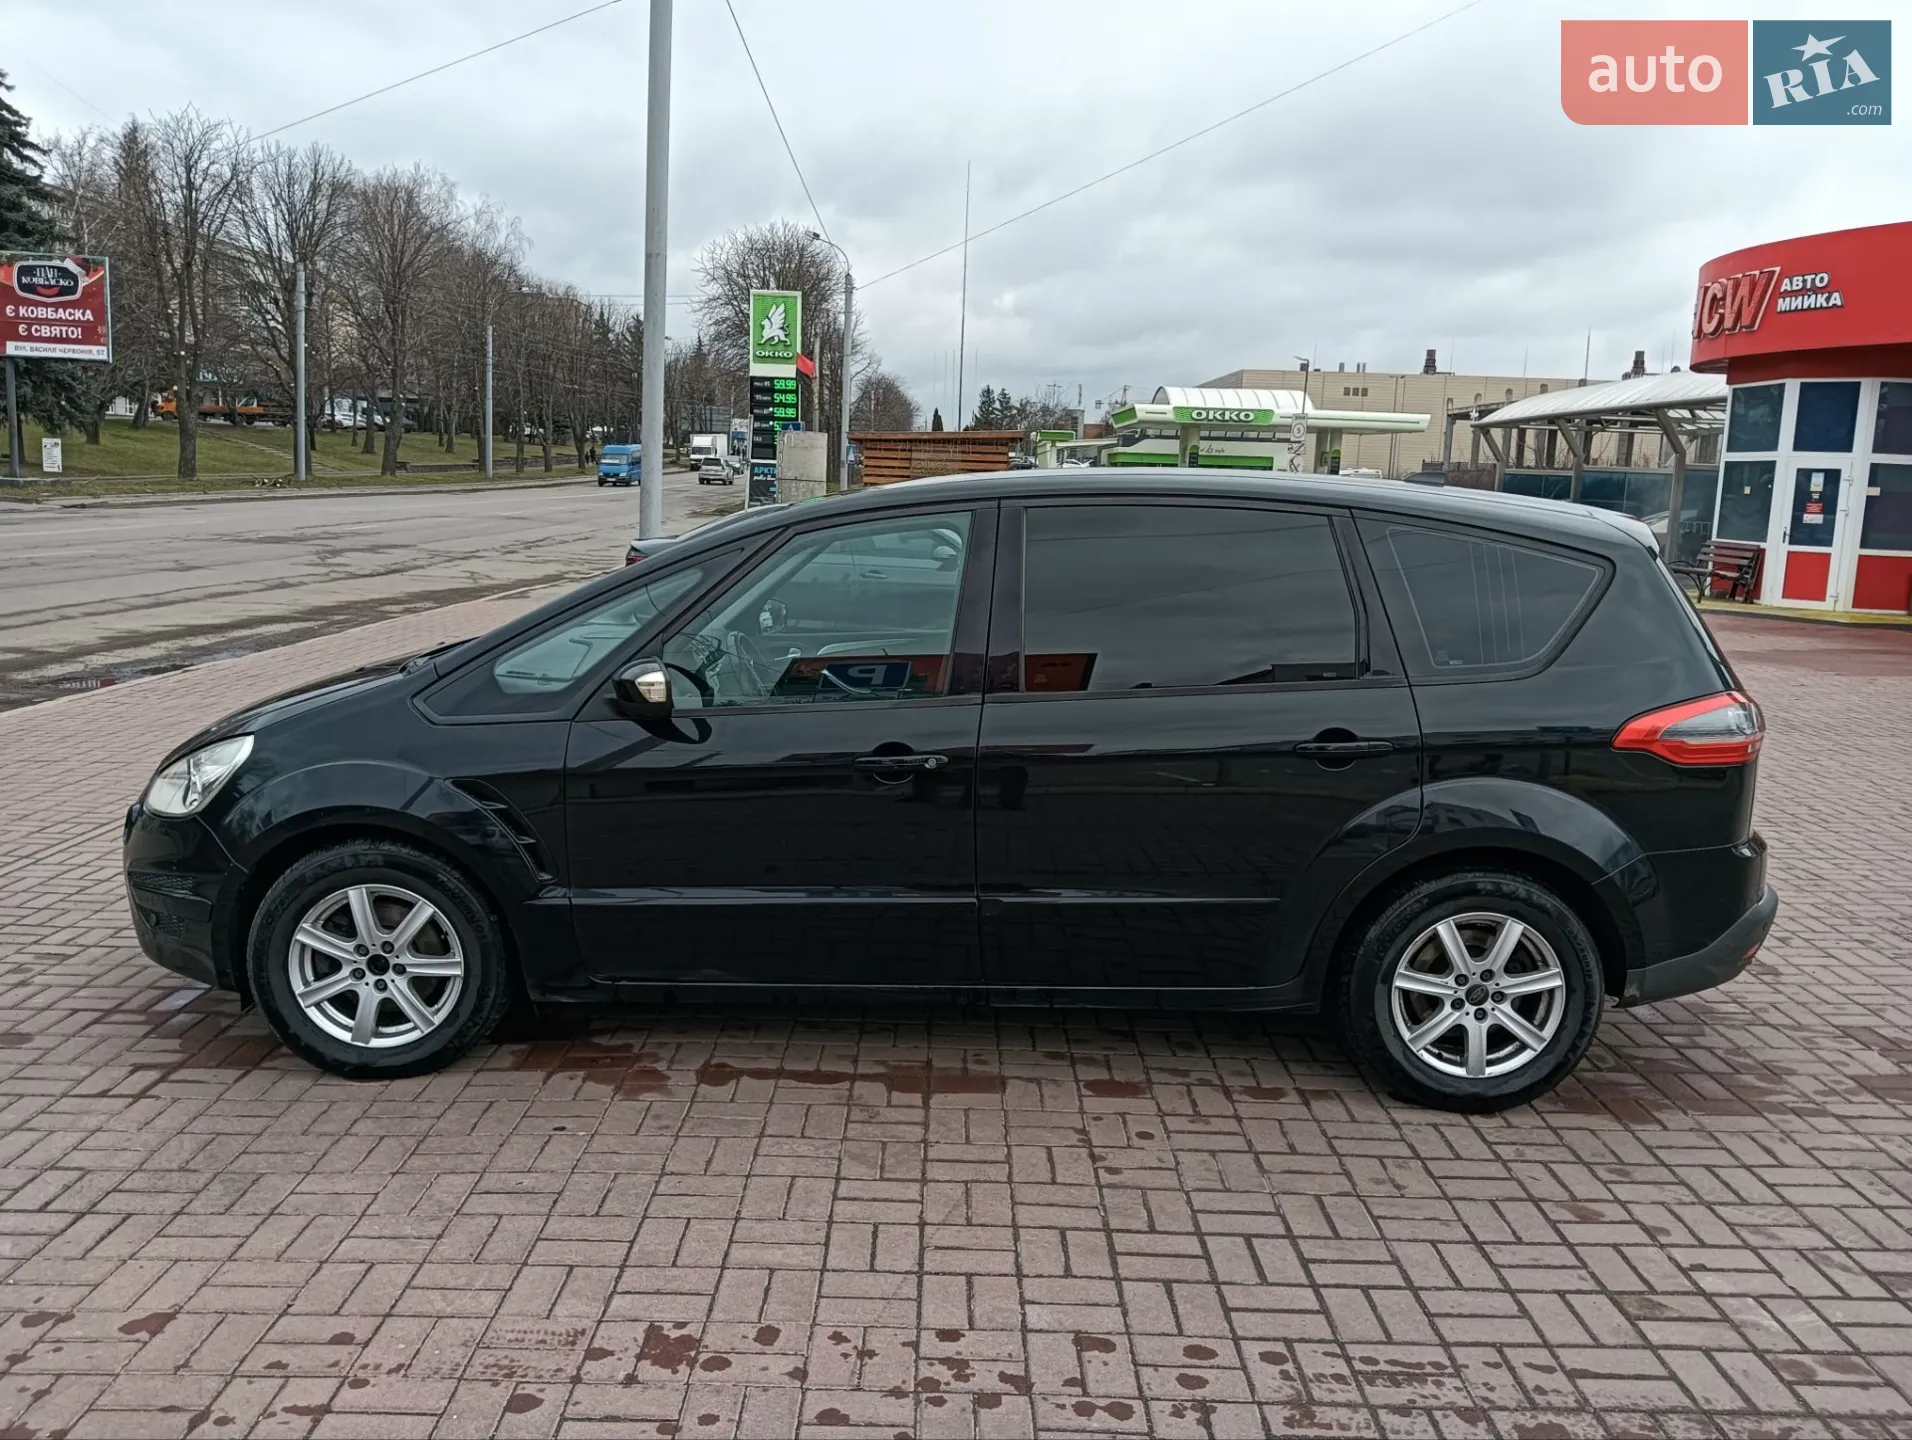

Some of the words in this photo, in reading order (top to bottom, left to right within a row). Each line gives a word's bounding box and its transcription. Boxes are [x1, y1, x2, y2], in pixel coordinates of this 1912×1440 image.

[22, 276, 74, 287] КОВБАСКО
[1779, 272, 1831, 293] АВТО
[1776, 291, 1844, 313] МИЙКА
[6, 305, 16, 317] Є
[19, 306, 94, 321] КОВБАСКА
[18, 324, 28, 336] Є
[31, 325, 82, 339] СВЯТО!
[755, 350, 793, 358] OKKO
[773, 379, 797, 390] 59.99
[773, 392, 797, 403] 54.99
[773, 407, 797, 418] 59.99
[1191, 408, 1255, 422] OKKO
